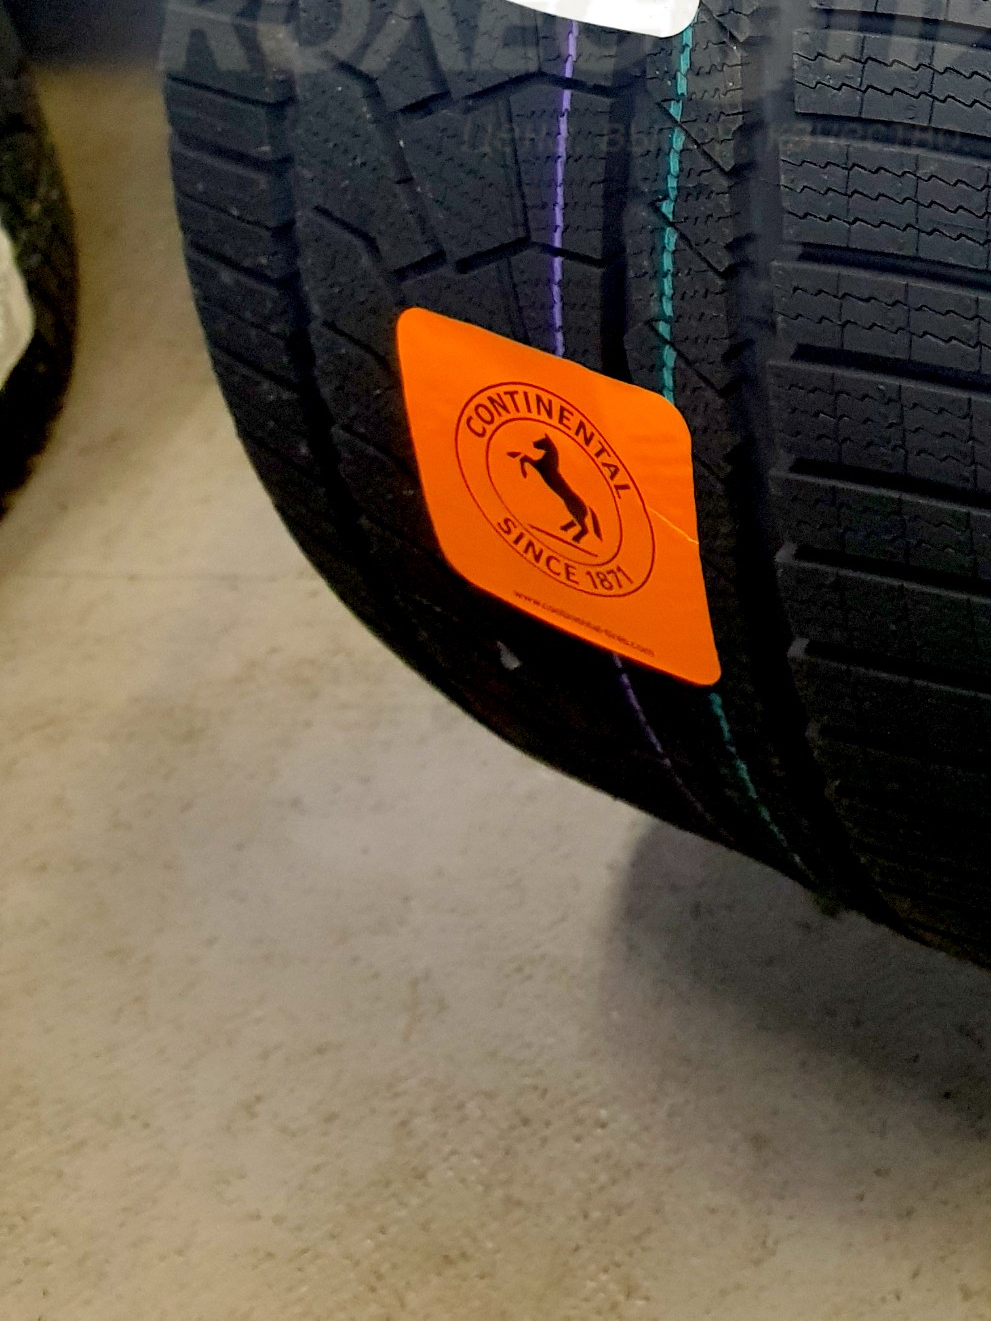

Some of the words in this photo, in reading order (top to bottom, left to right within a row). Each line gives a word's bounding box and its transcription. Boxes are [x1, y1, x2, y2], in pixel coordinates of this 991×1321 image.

[466, 389, 633, 500] CONTINENTAL
[497, 516, 580, 586] SINCE
[584, 564, 635, 592] 1871
